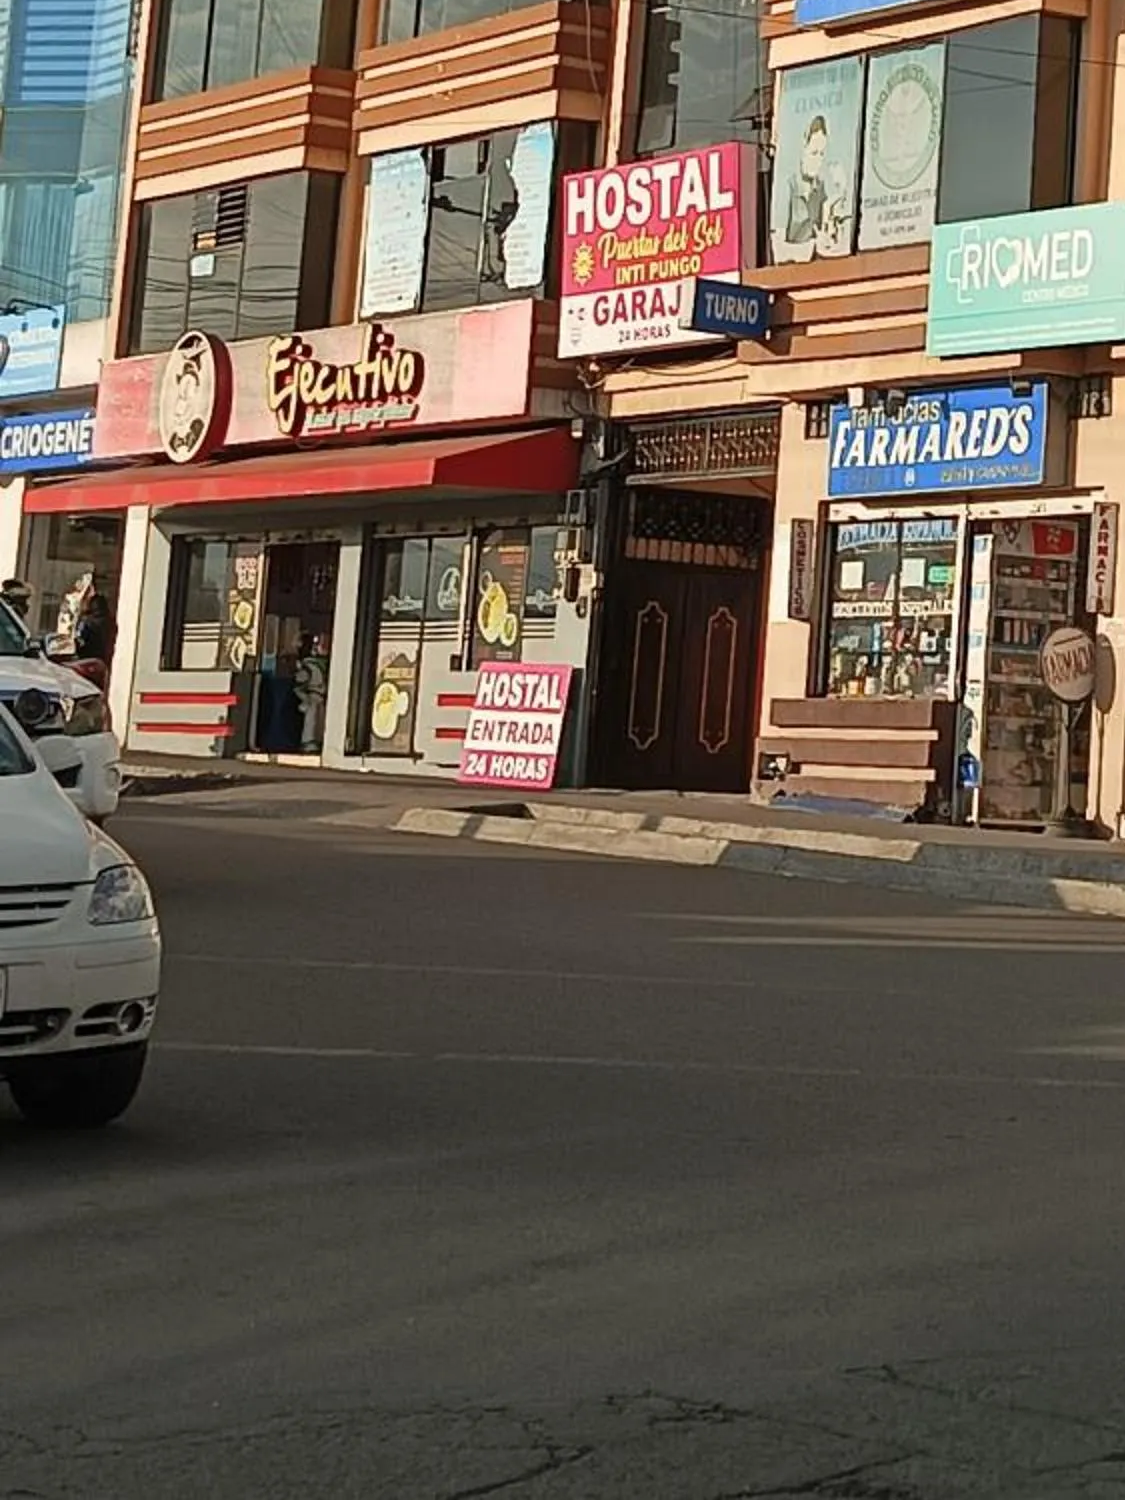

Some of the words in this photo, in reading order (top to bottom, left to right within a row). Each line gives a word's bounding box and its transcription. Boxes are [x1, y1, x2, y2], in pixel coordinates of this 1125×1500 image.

[566, 151, 734, 236] HOSTAL
[663, 222, 689, 253] del
[693, 214, 724, 252] Sol
[649, 254, 702, 280] PUNGO
[961, 228, 1095, 292] RIOMED
[704, 291, 760, 325] TURNO
[267, 322, 416, 436] Ejecutivo
[475, 671, 562, 709] HOSTAL
[470, 719, 555, 745] ENTRADA
[464, 753, 487, 775] 24
[489, 754, 549, 781] HORAS
